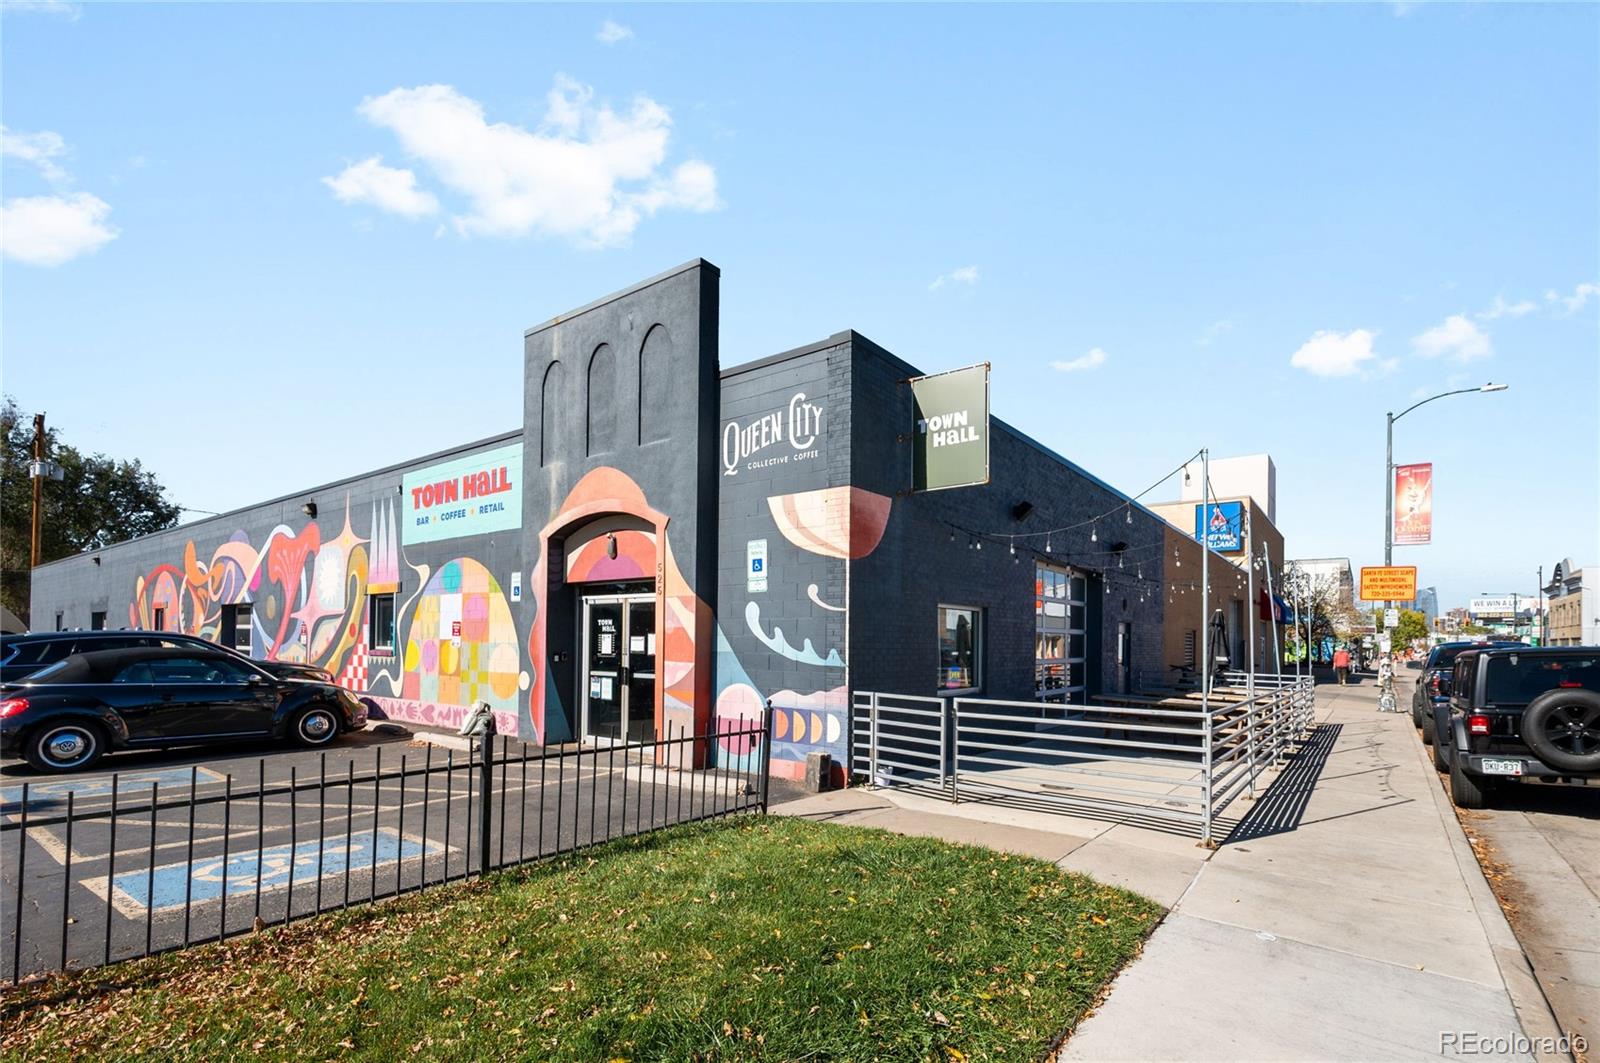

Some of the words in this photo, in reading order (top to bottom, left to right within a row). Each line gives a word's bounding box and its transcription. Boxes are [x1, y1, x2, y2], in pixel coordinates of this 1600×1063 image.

[723, 411, 782, 476] QUEEN
[789, 392, 823, 449] CITY
[918, 410, 968, 434] TOWN
[747, 456, 788, 470] COLLECTIVE
[793, 450, 819, 461] COFFEE
[411, 478, 459, 510] TOWN
[416, 516, 430, 526] BAR
[440, 509, 467, 521] COFFEE
[479, 502, 505, 514] RETAIL
